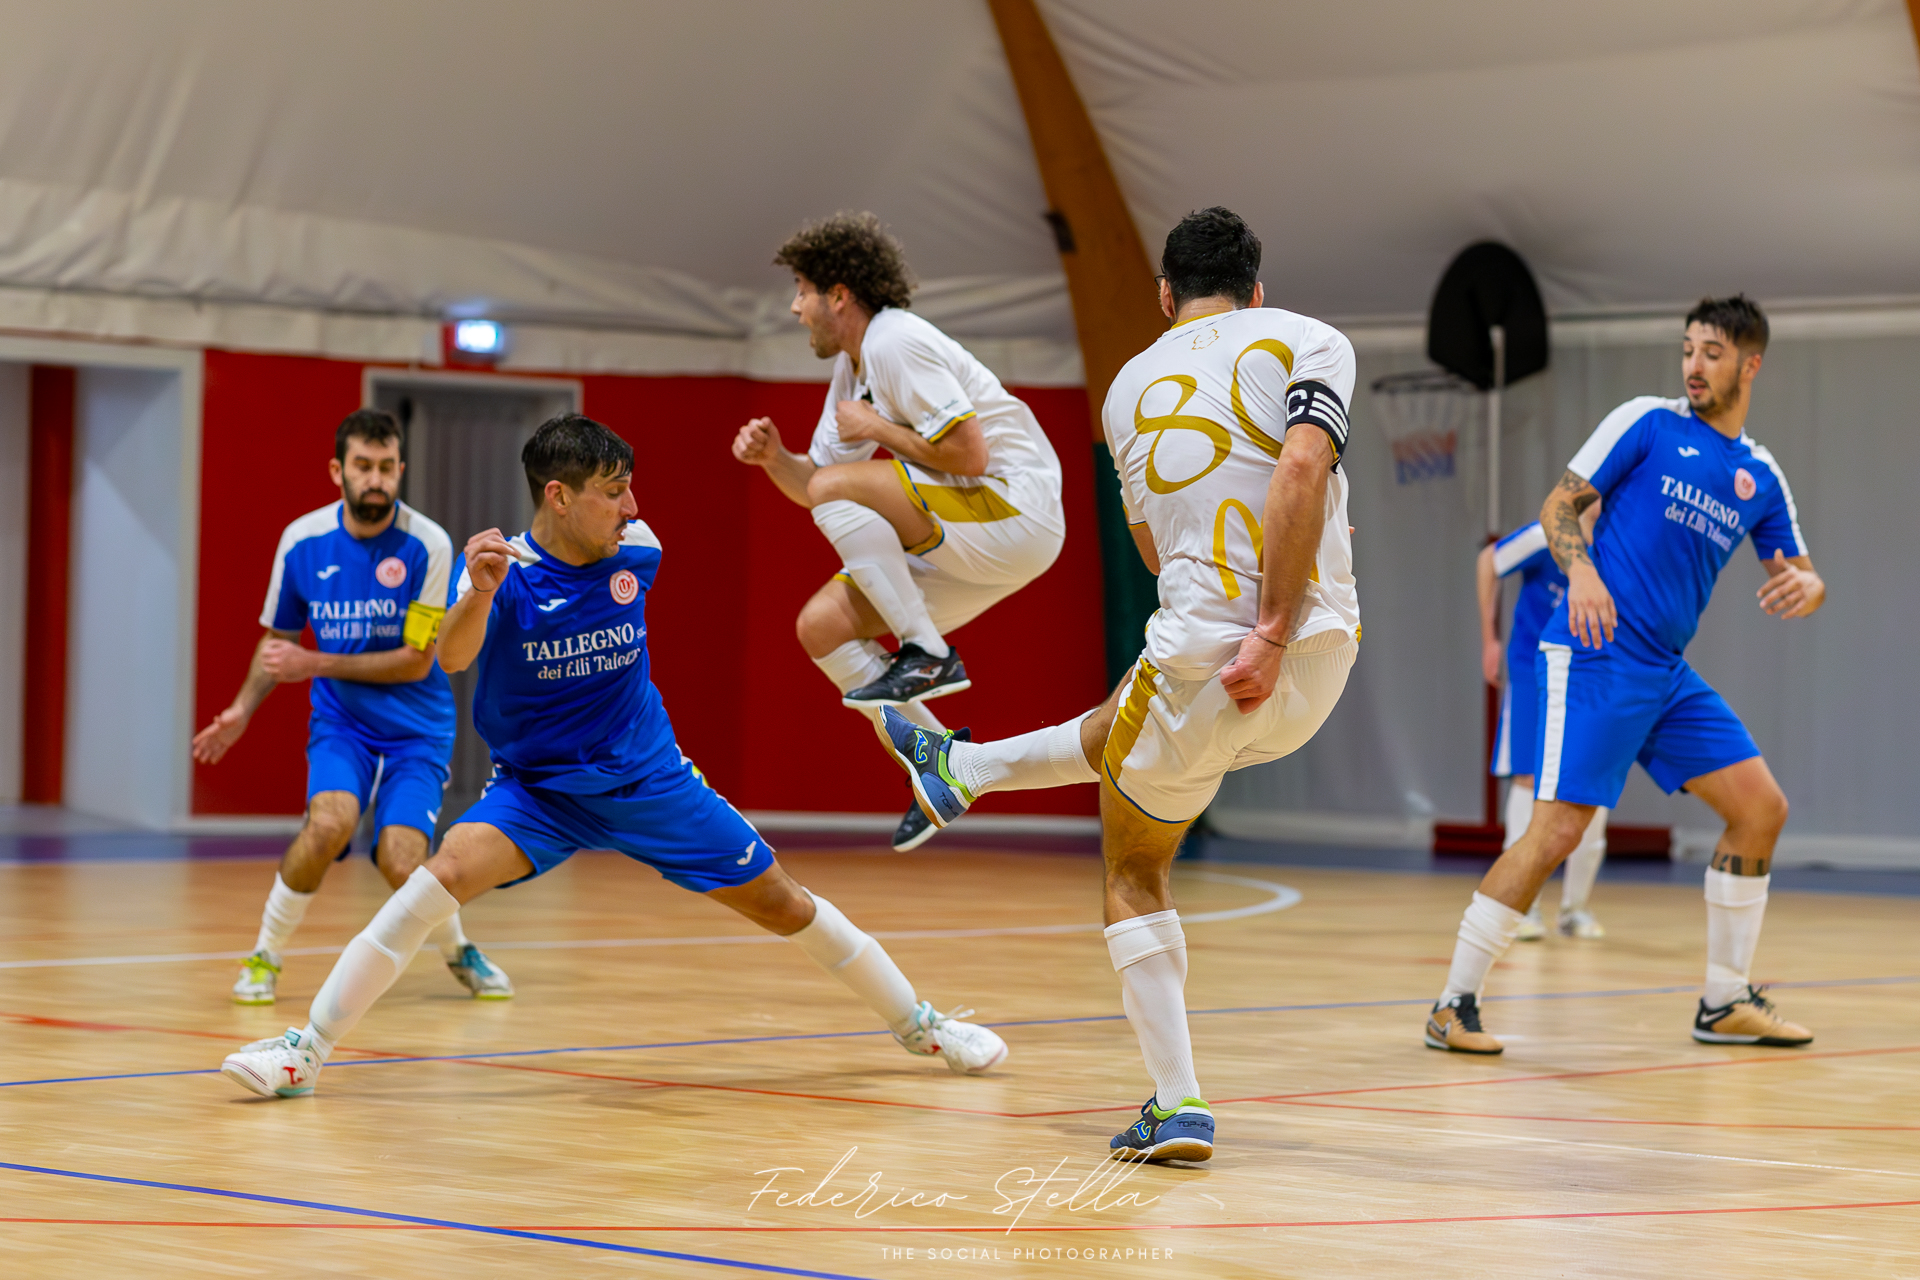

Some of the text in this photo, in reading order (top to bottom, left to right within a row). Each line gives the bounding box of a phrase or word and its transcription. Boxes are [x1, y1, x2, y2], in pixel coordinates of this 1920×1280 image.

[1661, 475, 1740, 529] TALLEGNO
[522, 623, 634, 661] TALLEGNO
[537, 664, 562, 679] dei
[566, 657, 591, 677] f.lli
